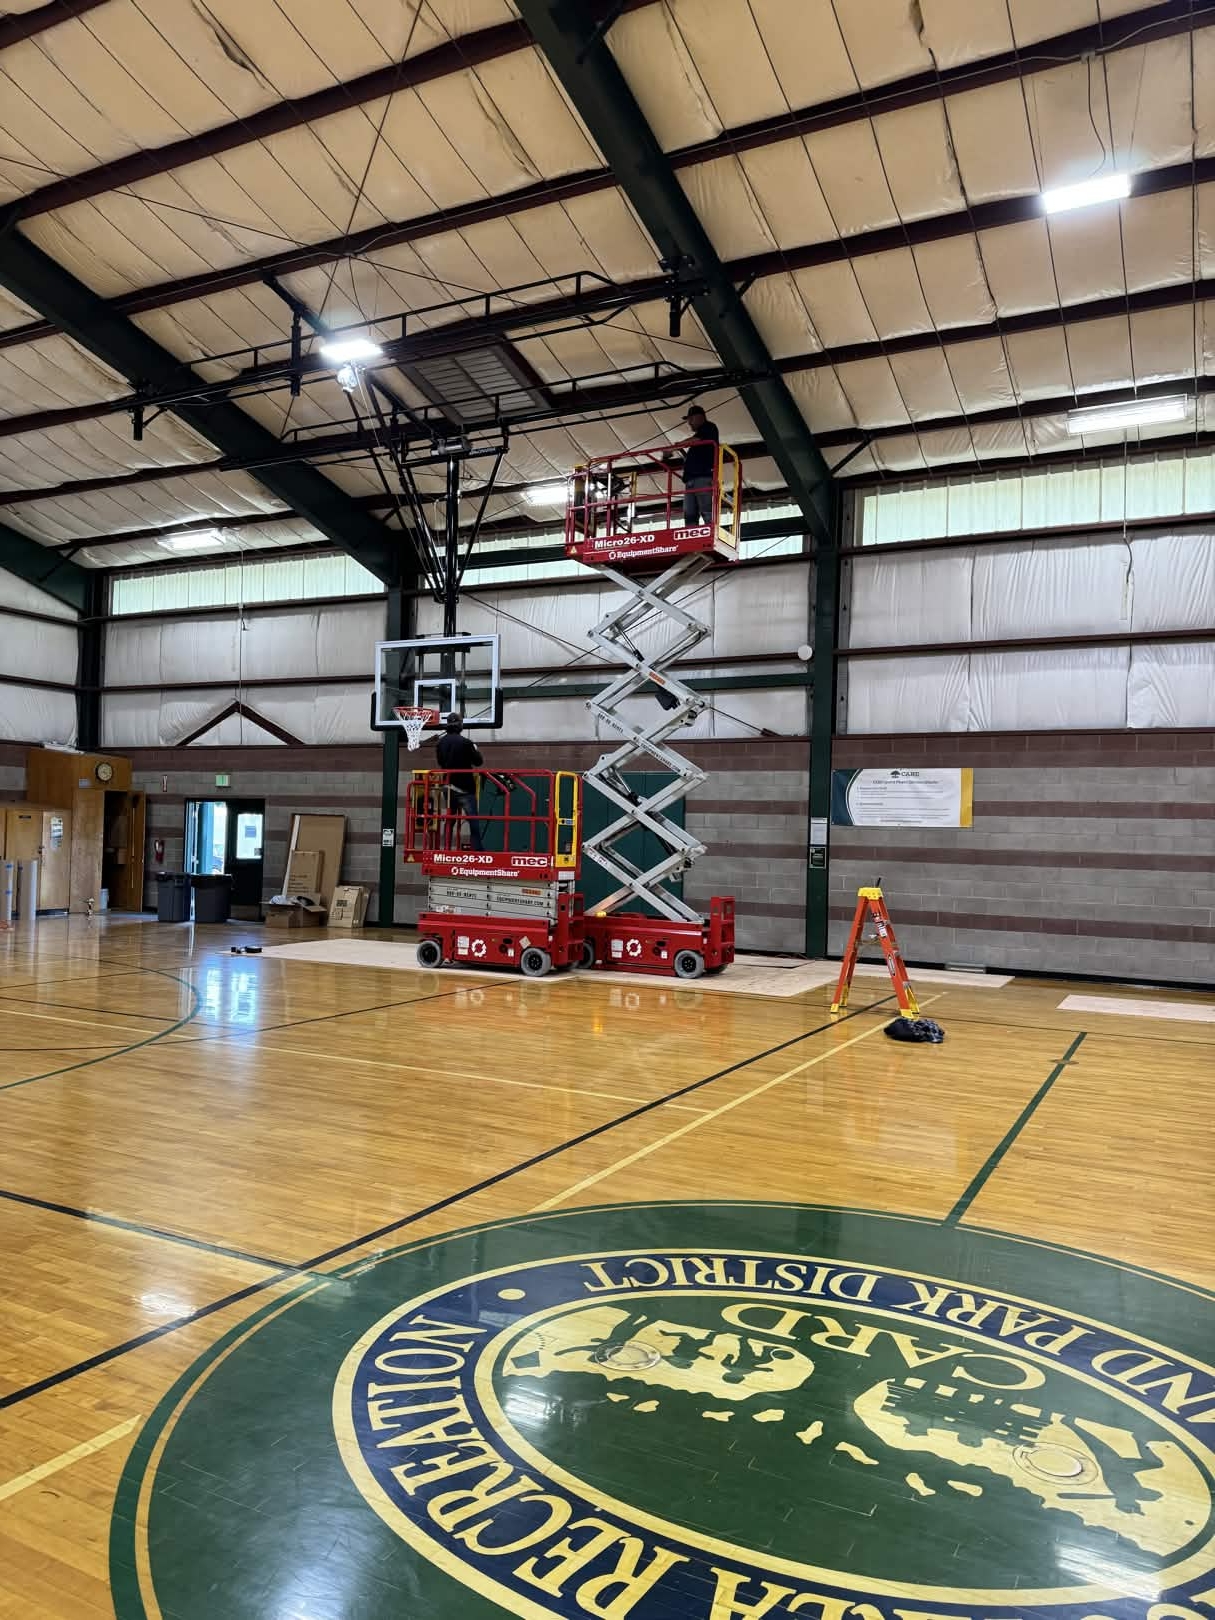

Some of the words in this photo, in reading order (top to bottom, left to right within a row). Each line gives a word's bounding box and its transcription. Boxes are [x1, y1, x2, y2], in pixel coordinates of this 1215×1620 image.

[675, 527, 711, 540] mec
[594, 534, 655, 549] Micro26-XD
[617, 545, 677, 558] EquipmentShare
[433, 854, 493, 864] Micro26-XD
[512, 856, 547, 867] mec
[459, 868, 519, 877] EquipmentShare
[580, 1257, 882, 1302] DISTRICT
[893, 1281, 1095, 1356] PARK
[720, 1303, 1046, 1390] CARD
[367, 1314, 690, 1620] RECREATION
